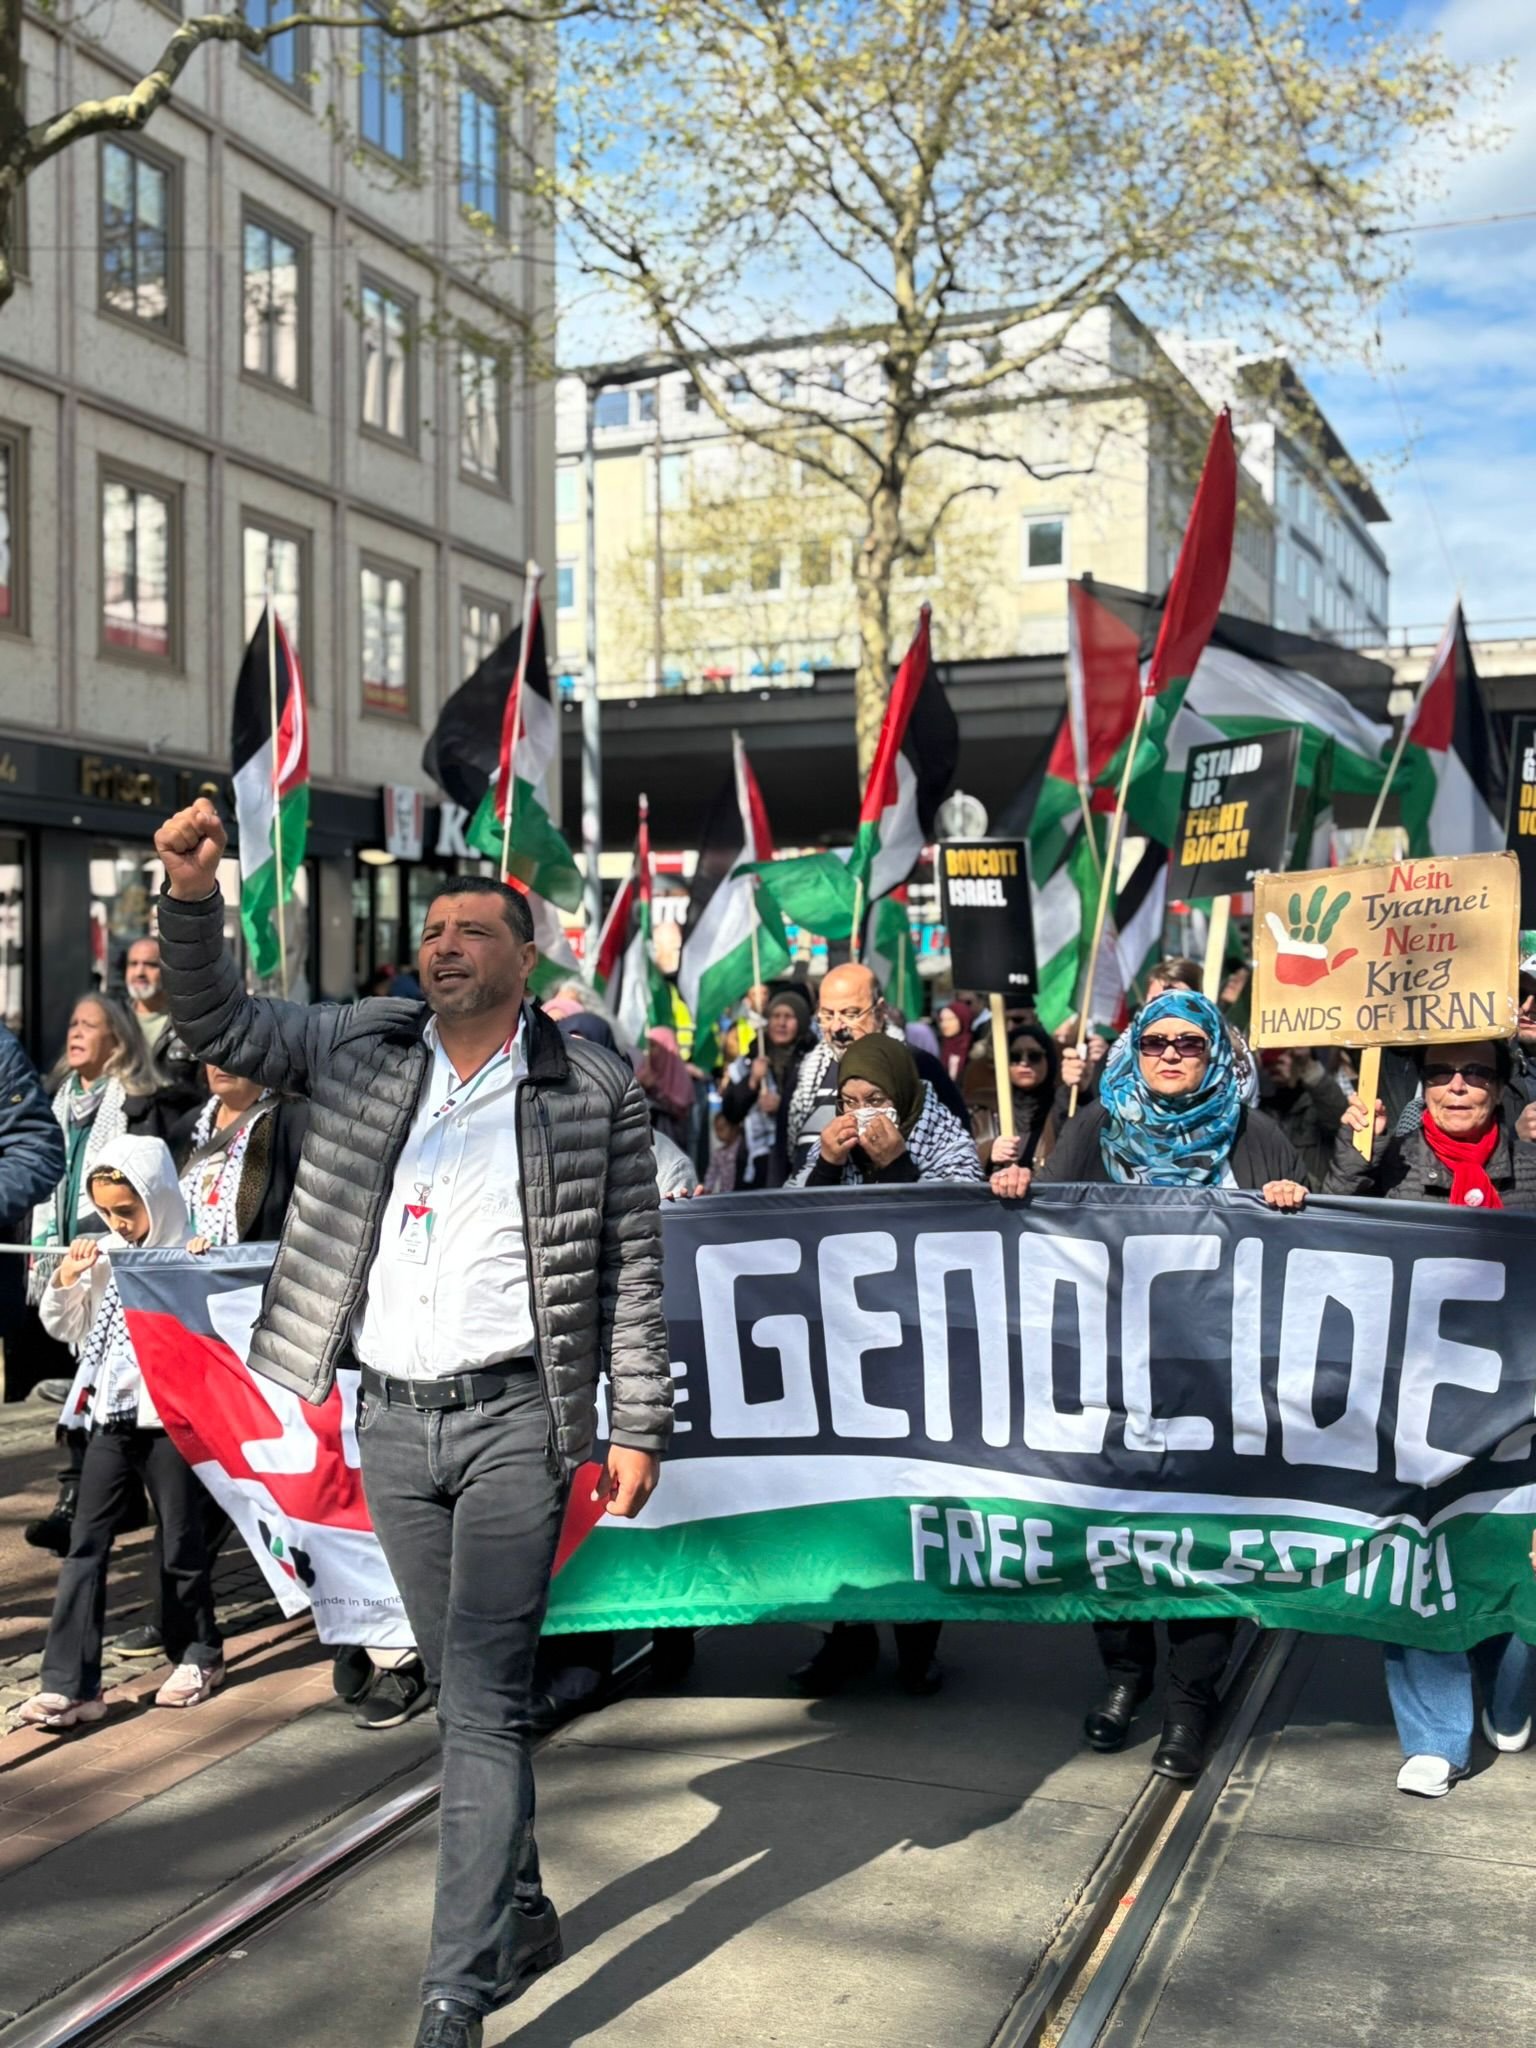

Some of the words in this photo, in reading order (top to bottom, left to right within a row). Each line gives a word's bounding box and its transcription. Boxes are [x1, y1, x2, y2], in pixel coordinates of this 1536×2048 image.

[1193, 743, 1262, 780] STAND
[1189, 779, 1222, 809] UP.
[1185, 800, 1248, 837] FIGHT
[945, 849, 1017, 877] BOYCOTT
[1181, 829, 1250, 866] BACK!
[948, 879, 1008, 907] ISRAEL
[1388, 864, 1453, 894] Nein
[1361, 886, 1490, 931] Tyrannei
[1383, 923, 1458, 957] Nein
[1364, 958, 1453, 998] Krieg
[1261, 1006, 1342, 1034] HANDS
[1403, 991, 1498, 1031] IRAN
[695, 1231, 1506, 1489] GENOCIDE
[910, 1504, 1062, 1589] FREE
[1086, 1527, 1457, 1618] PALESTINE!
[313, 1596, 346, 1608] einde
[349, 1597, 360, 1607] in
[363, 1594, 402, 1608] Breme
